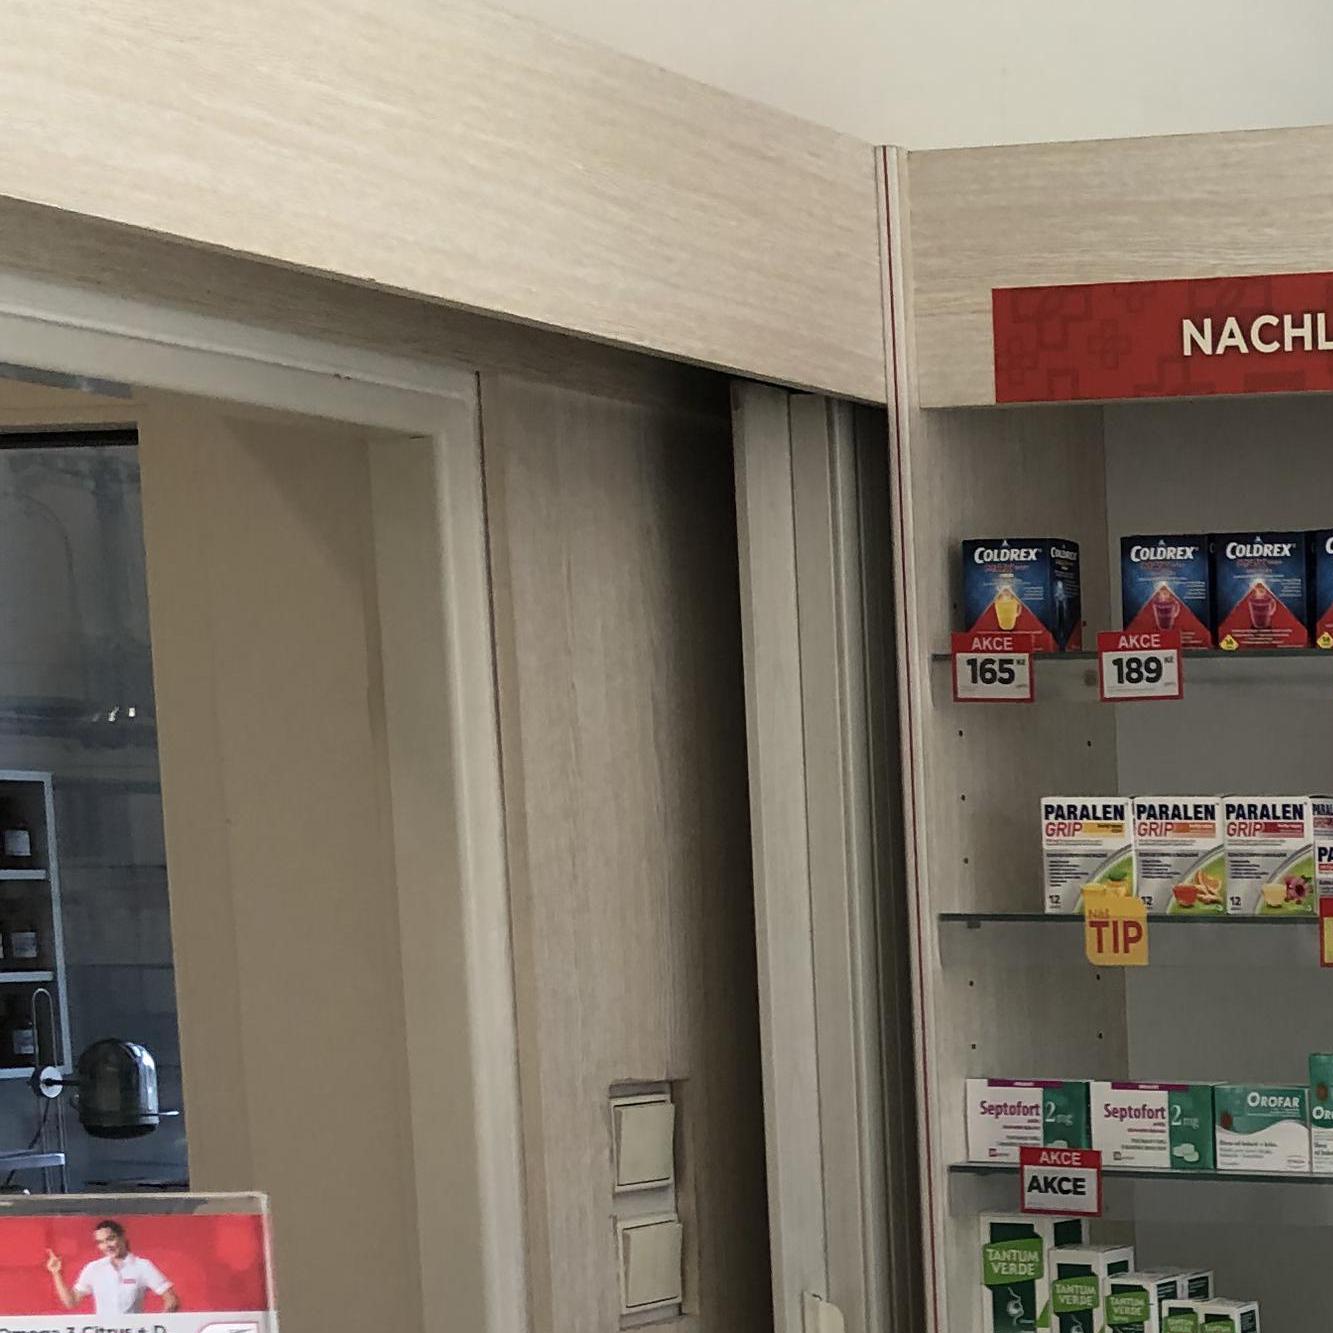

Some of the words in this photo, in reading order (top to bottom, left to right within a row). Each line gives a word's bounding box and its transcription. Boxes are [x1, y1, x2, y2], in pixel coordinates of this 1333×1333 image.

[974, 546, 1039, 565] COLDREX
[1131, 545, 1194, 563] COLDREX
[1226, 541, 1293, 560] COLDREX
[971, 637, 1014, 652] AKCE
[966, 659, 1016, 685] 165
[1112, 657, 1164, 684] 189
[1044, 804, 1125, 820] PARALEN
[1136, 803, 1216, 820] PARALEN
[1225, 803, 1304, 820] PARALEN
[1045, 822, 1083, 837] GRIP
[1137, 822, 1175, 837] GRIP
[1227, 822, 1264, 837] GRIP
[1087, 920, 1143, 954] TIP
[1247, 1092, 1301, 1109] OROFAR
[979, 1100, 1041, 1120] Septofort
[1103, 1103, 1167, 1121] Septofort
[1039, 1152, 1081, 1166] AKCE
[1027, 1175, 1087, 1196] AKCE
[986, 1248, 1039, 1264] TANTUM
[990, 1261, 1035, 1277] VERDE
